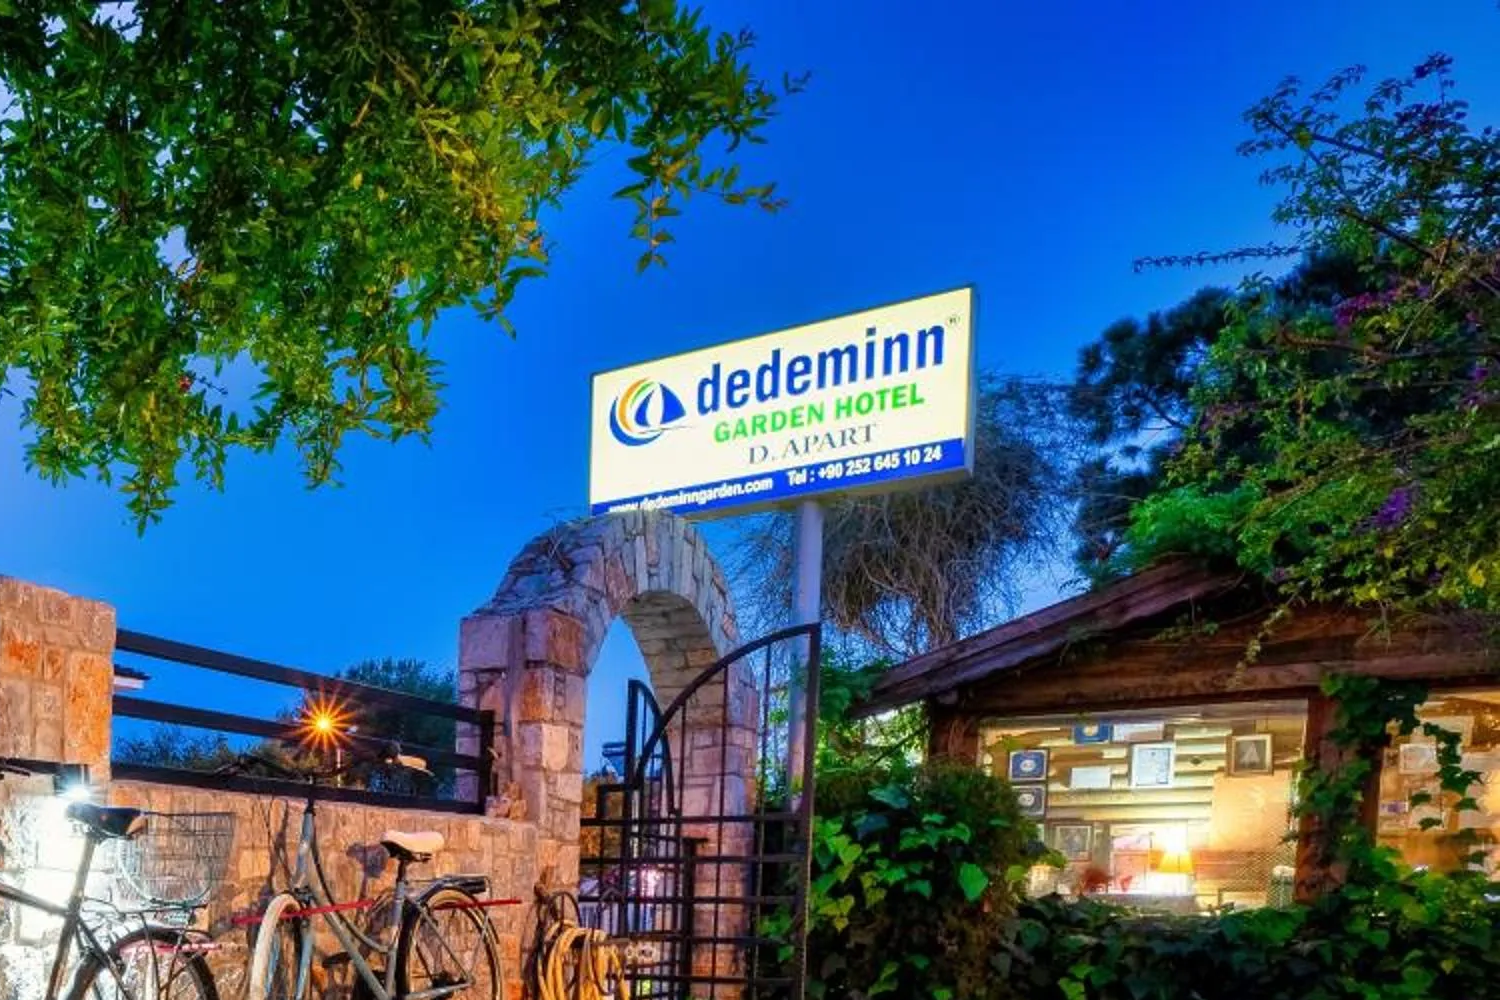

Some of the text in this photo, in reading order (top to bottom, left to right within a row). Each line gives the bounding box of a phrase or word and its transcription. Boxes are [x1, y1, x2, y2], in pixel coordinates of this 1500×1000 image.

[697, 324, 945, 416] dedeminn
[713, 382, 925, 443] GARDEN HOTEL
[750, 423, 877, 465] D. APART
[786, 470, 807, 486] Tel
[845, 457, 871, 477] 252
[874, 452, 900, 471] 645
[904, 450, 920, 467] 10
[923, 445, 943, 462] 24
